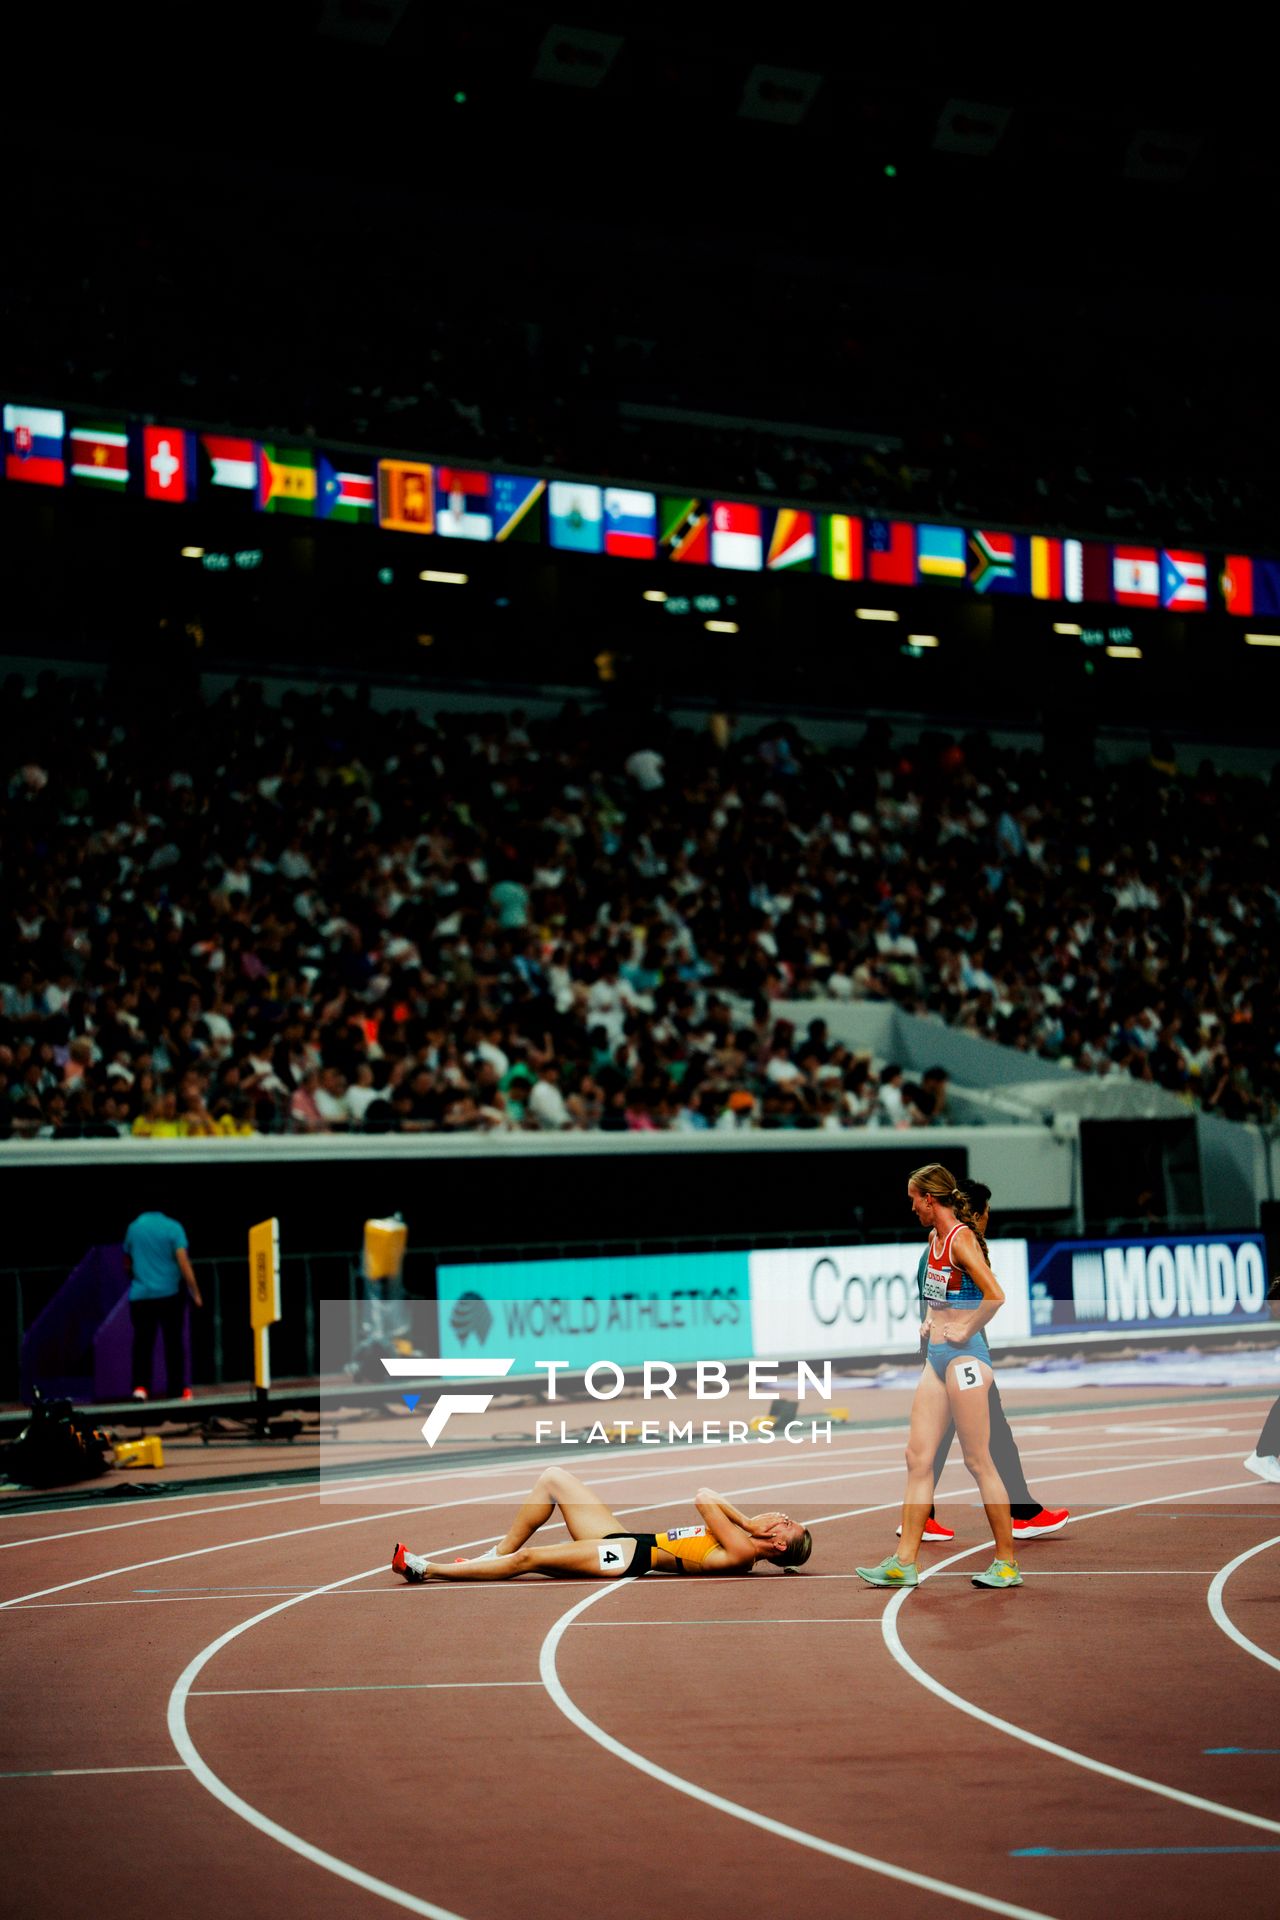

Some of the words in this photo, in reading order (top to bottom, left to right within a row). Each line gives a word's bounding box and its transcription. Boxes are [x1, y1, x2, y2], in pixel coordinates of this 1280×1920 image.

[927, 1270, 947, 1284] ONDA
[1103, 1242, 1265, 1323] MONDO
[504, 1297, 599, 1339] WORLD
[606, 1286, 740, 1332] ATHLETICS
[963, 1366, 977, 1386] 5
[603, 1550, 620, 1564] 4
